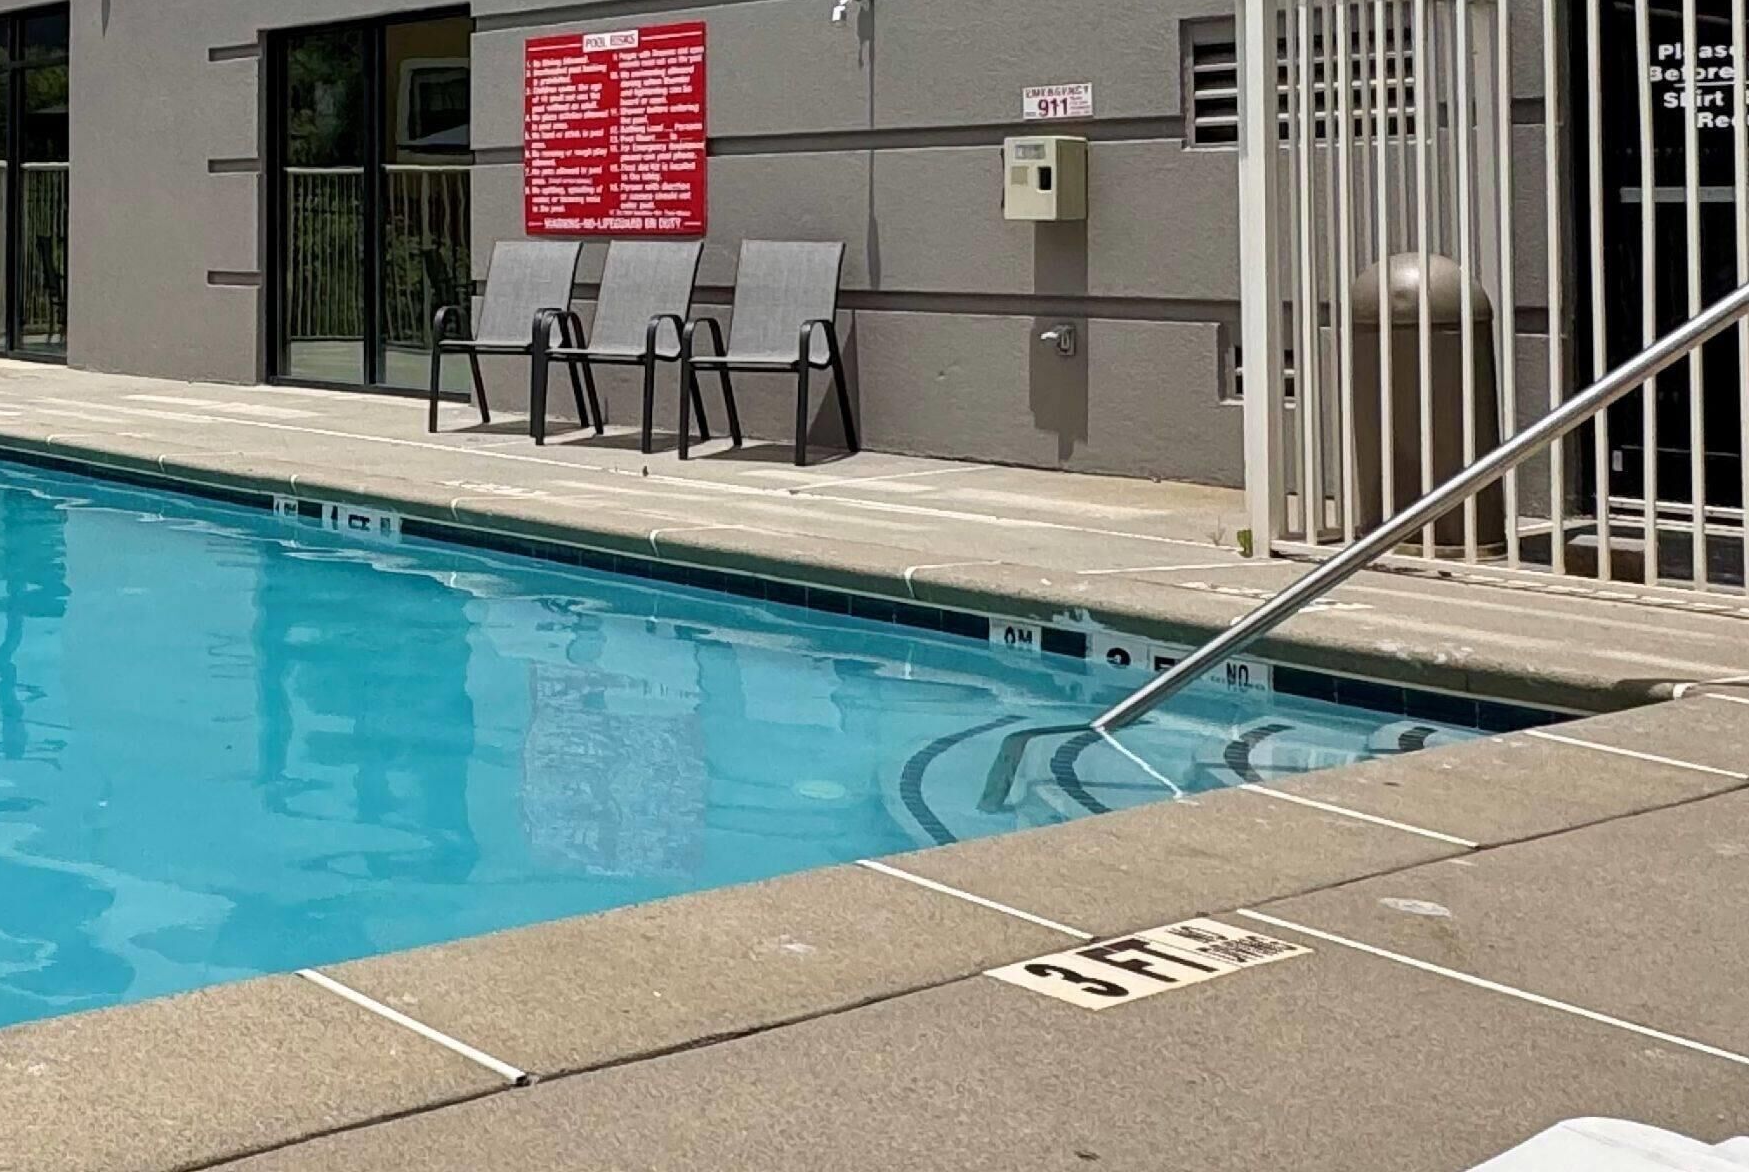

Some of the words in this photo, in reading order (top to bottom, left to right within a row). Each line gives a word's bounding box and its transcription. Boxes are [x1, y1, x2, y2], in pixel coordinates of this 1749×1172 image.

[1658, 42, 1734, 60] Plas
[1650, 66, 1734, 82] Beore
[1037, 97, 1068, 117] 911
[1075, 938, 1220, 984] FT
[1023, 963, 1130, 998] 3
